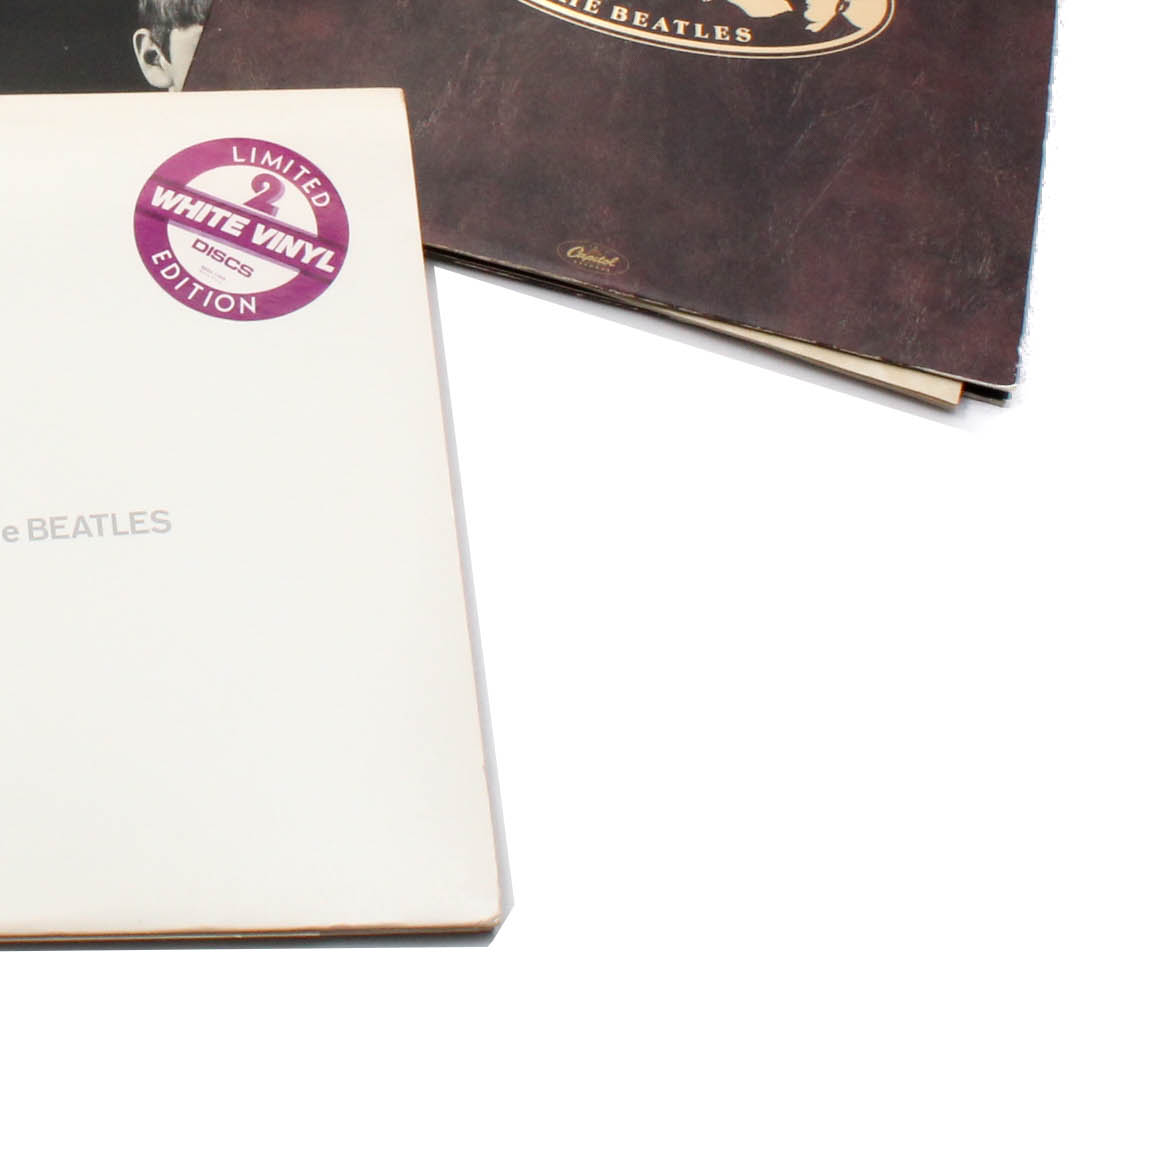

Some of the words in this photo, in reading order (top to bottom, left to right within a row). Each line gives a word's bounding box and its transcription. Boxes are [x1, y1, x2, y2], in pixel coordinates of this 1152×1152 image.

[609, 5, 753, 43] BEATLES
[232, 146, 331, 208] LIMITED
[242, 172, 286, 217] 2
[150, 185, 251, 238] WHITE
[250, 222, 336, 273] VINYL
[191, 238, 255, 279] DISCS
[151, 249, 257, 315] EDITION
[26, 509, 172, 542] BEATLES
